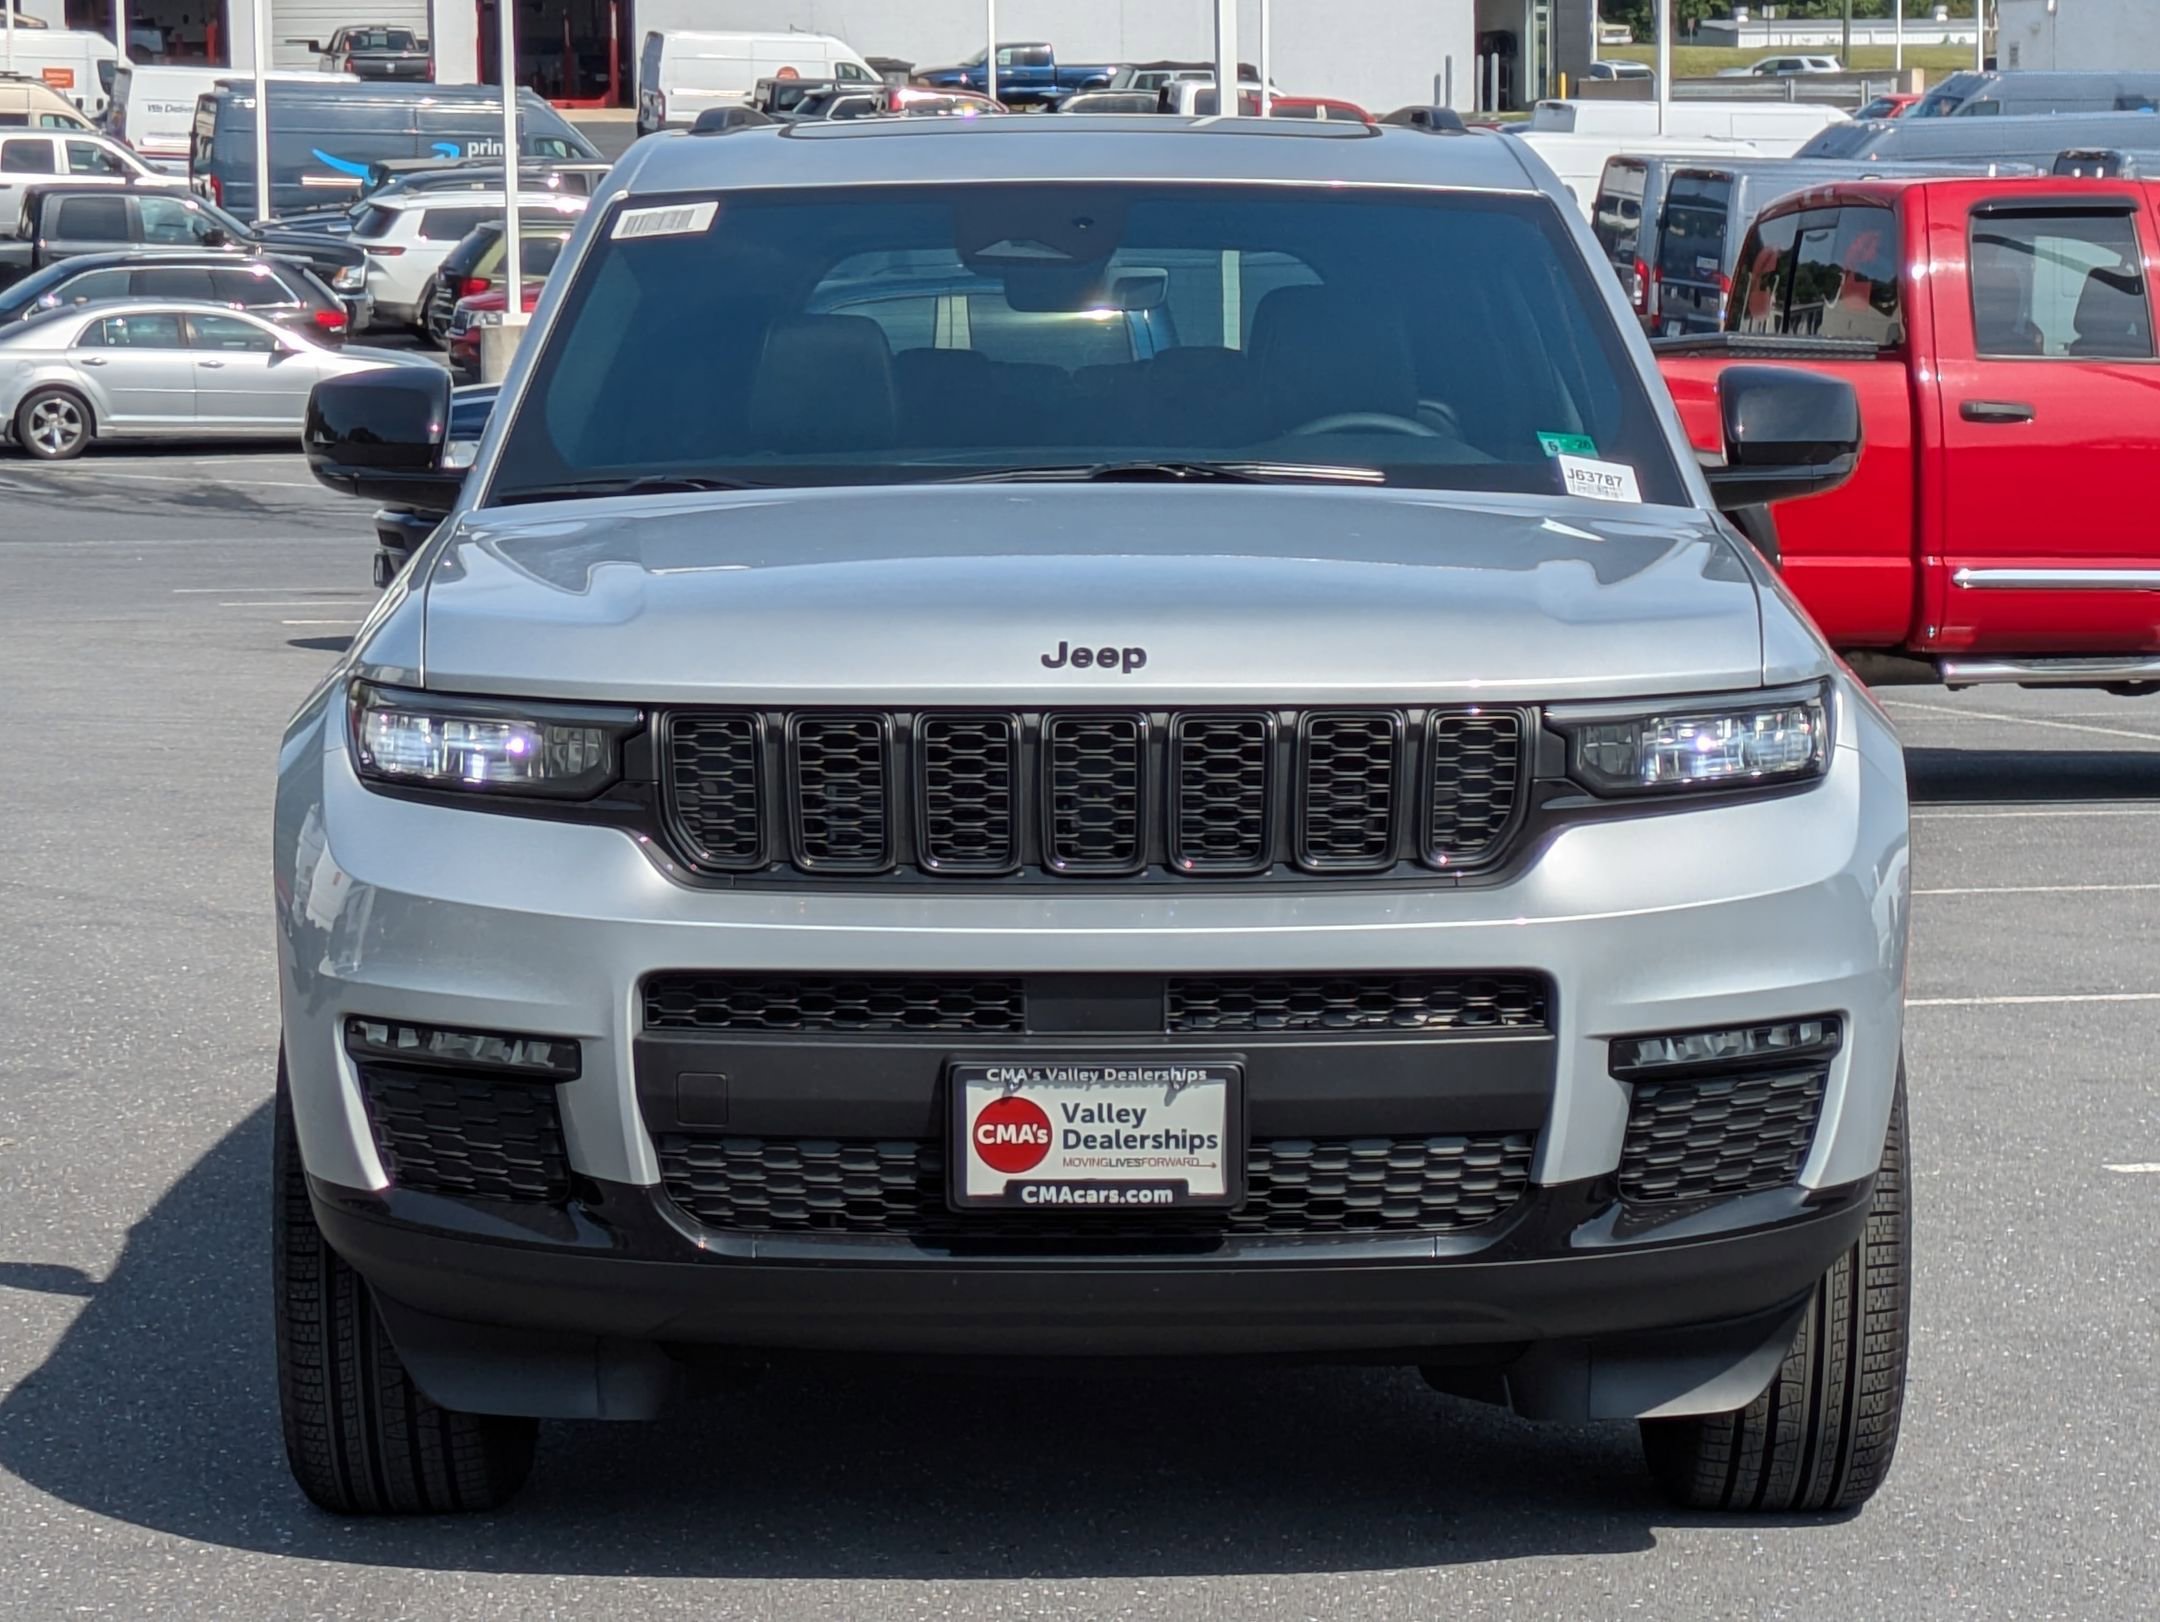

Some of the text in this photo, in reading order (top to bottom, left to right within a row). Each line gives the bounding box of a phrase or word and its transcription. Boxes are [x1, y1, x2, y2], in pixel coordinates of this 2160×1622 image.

[467, 138, 520, 159] prim
[1567, 468, 1623, 488] J63787
[1041, 641, 1147, 674] Jeep
[986, 1066, 1208, 1083] CMA's Valley Dealerships
[1061, 1102, 1147, 1128] Valley
[977, 1123, 1049, 1145] CMA's
[1062, 1128, 1218, 1155] Dealerships
[1021, 1185, 1174, 1204] CMAcars.com
